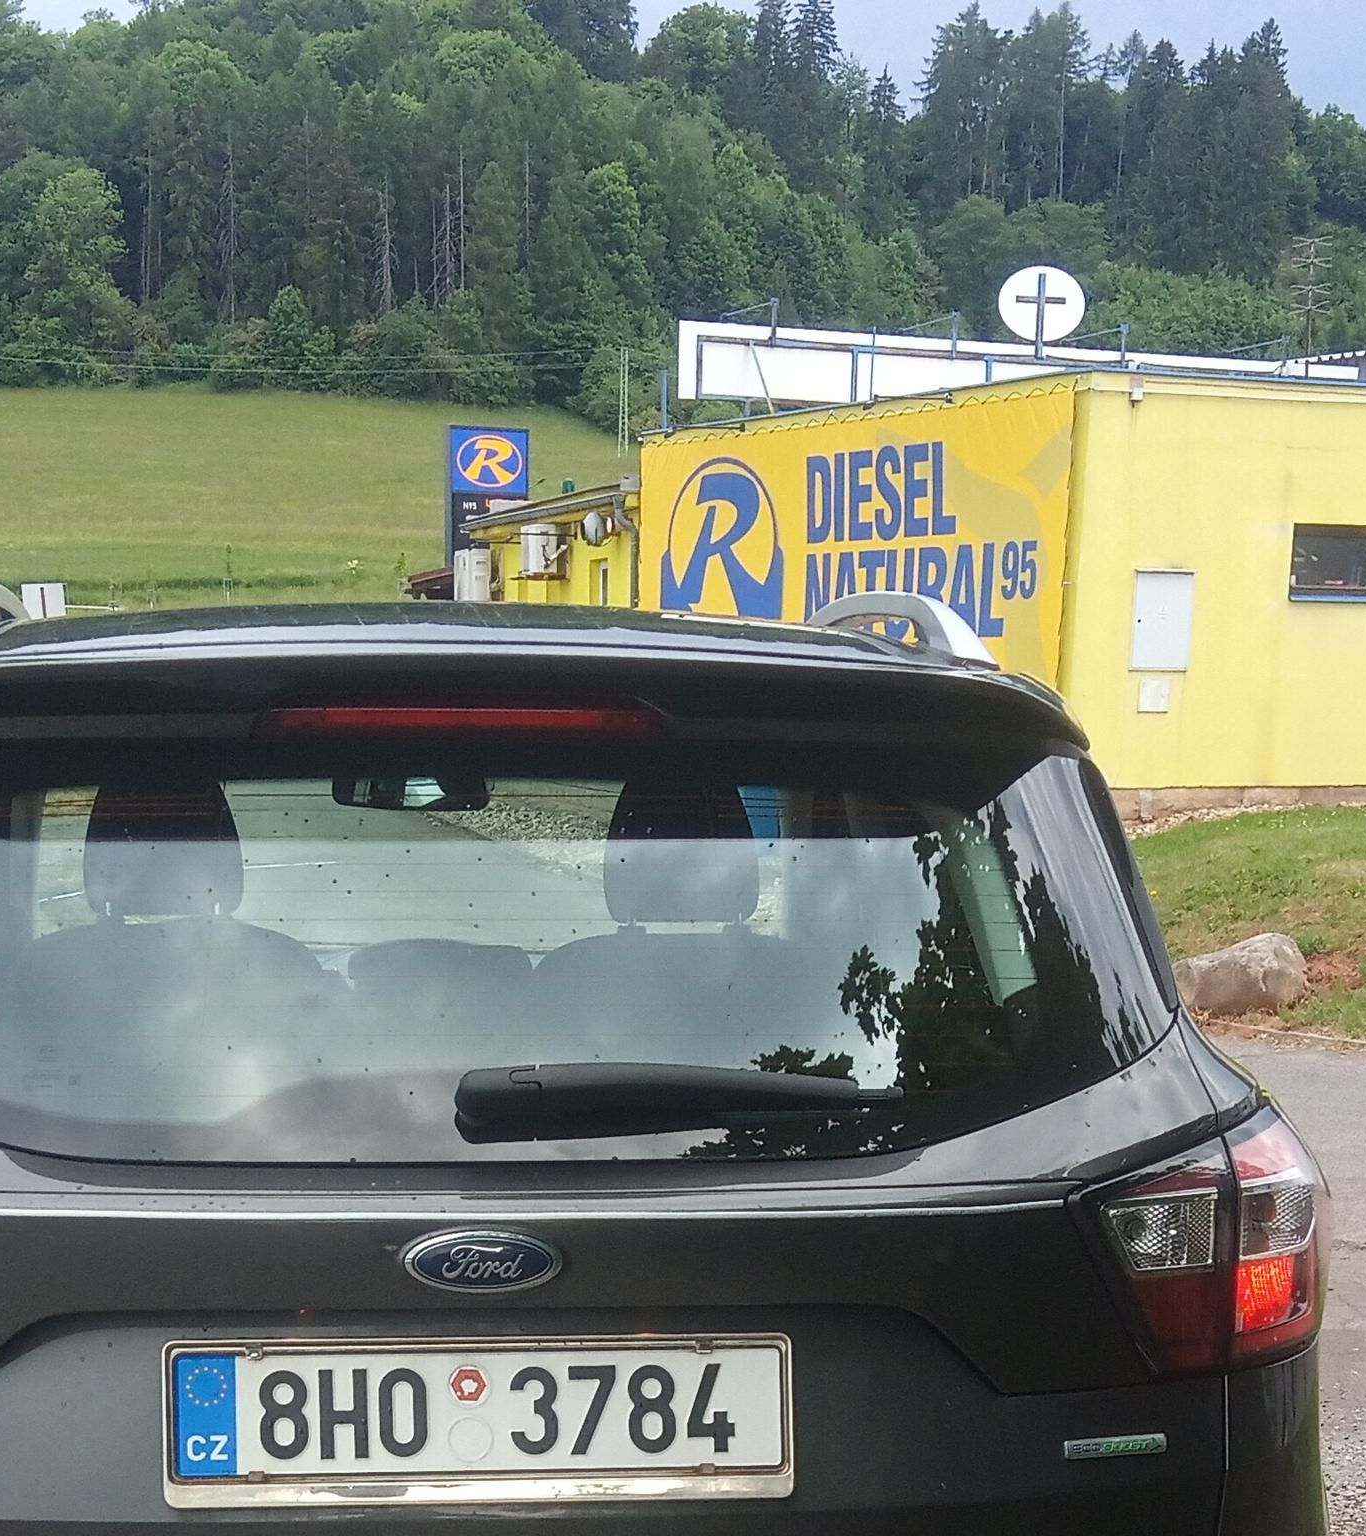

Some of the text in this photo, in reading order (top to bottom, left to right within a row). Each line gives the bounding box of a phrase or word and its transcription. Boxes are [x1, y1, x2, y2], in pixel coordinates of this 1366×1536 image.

[806, 441, 957, 544] DIESEL
[1000, 540, 1038, 600] 95
[441, 1244, 525, 1279] Ford
[509, 1363, 736, 1457] 3784
[186, 1434, 229, 1462] CZ
